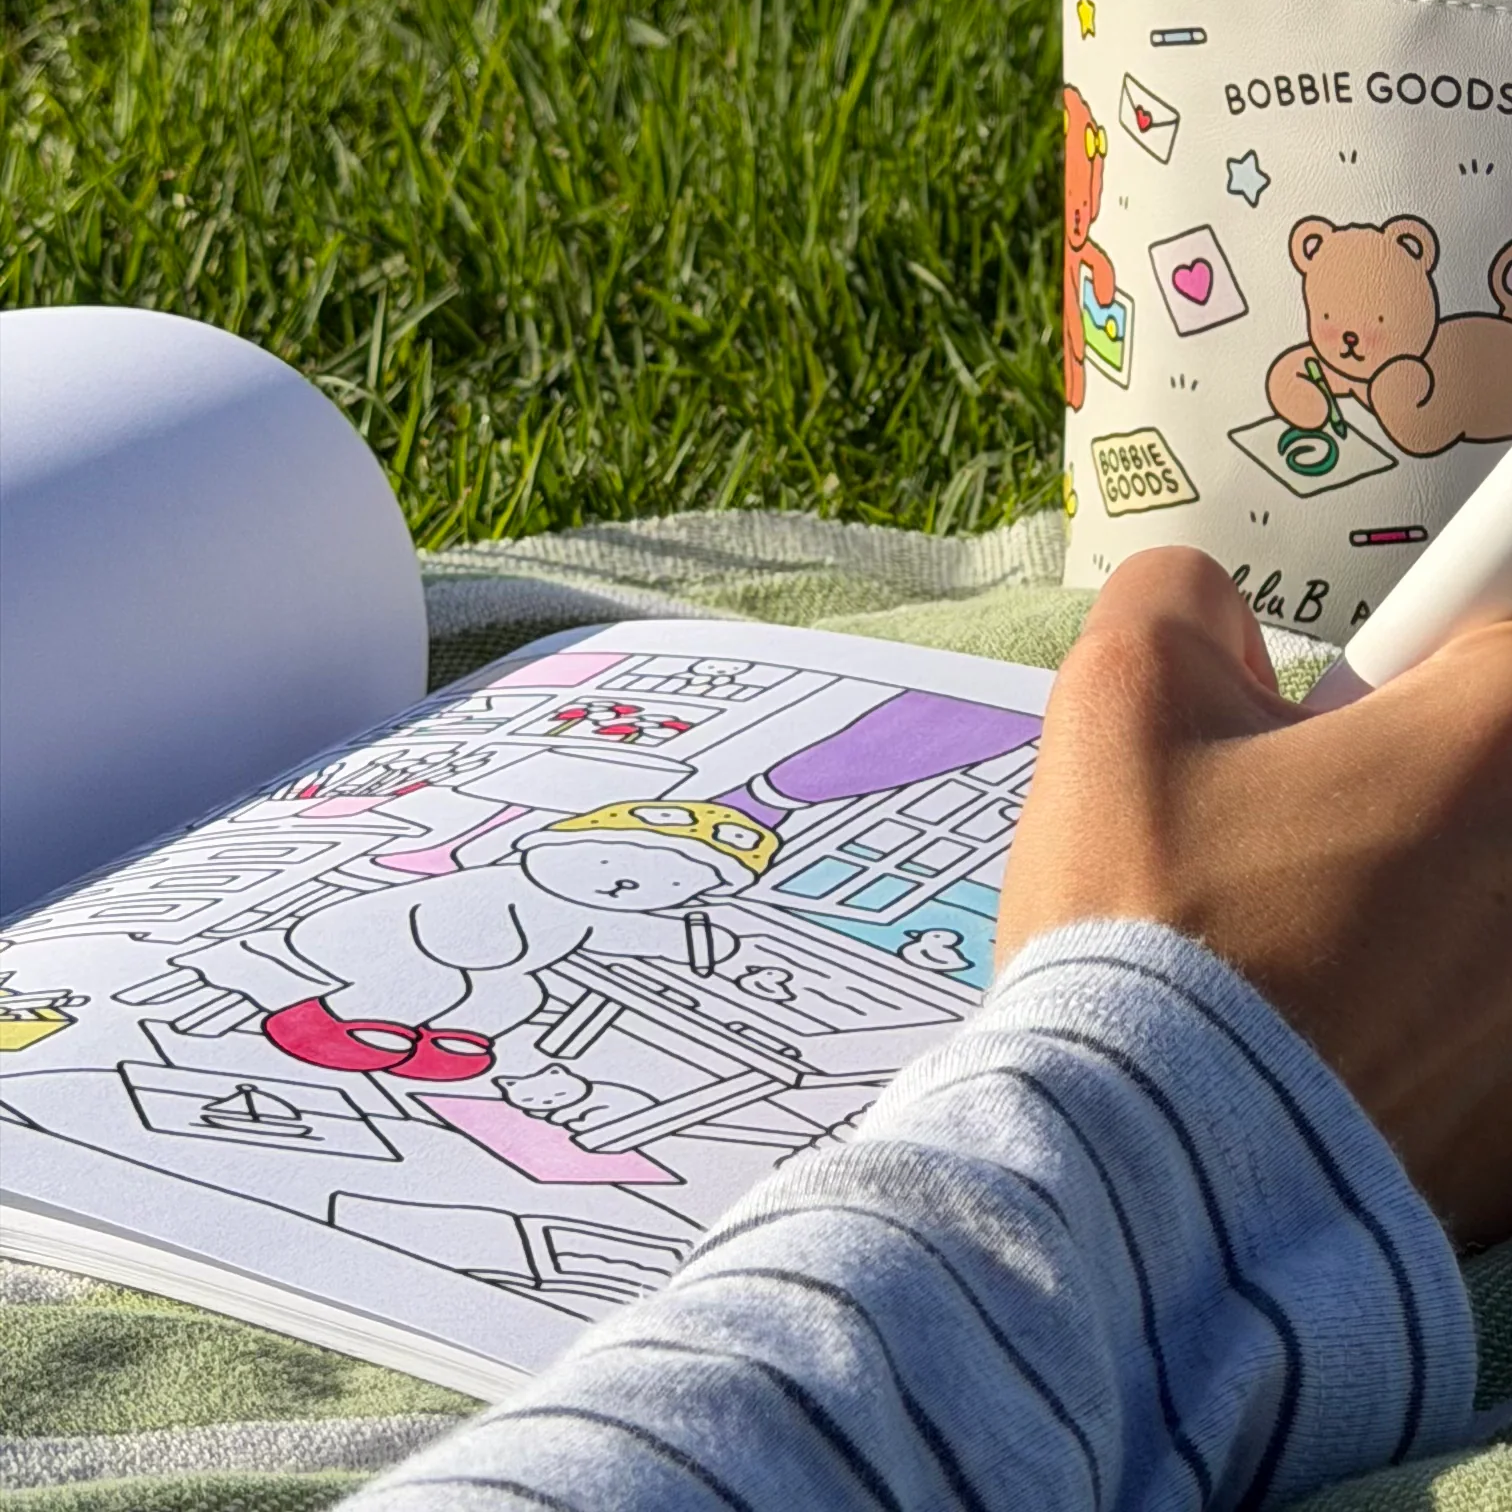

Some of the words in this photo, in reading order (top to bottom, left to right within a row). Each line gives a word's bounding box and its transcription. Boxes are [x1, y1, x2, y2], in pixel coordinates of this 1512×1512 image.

[1224, 72, 1353, 116] BOBBIE
[1099, 443, 1167, 477] BOBBIE
[1106, 468, 1180, 503] GOODS
[1294, 579, 1330, 623] B
